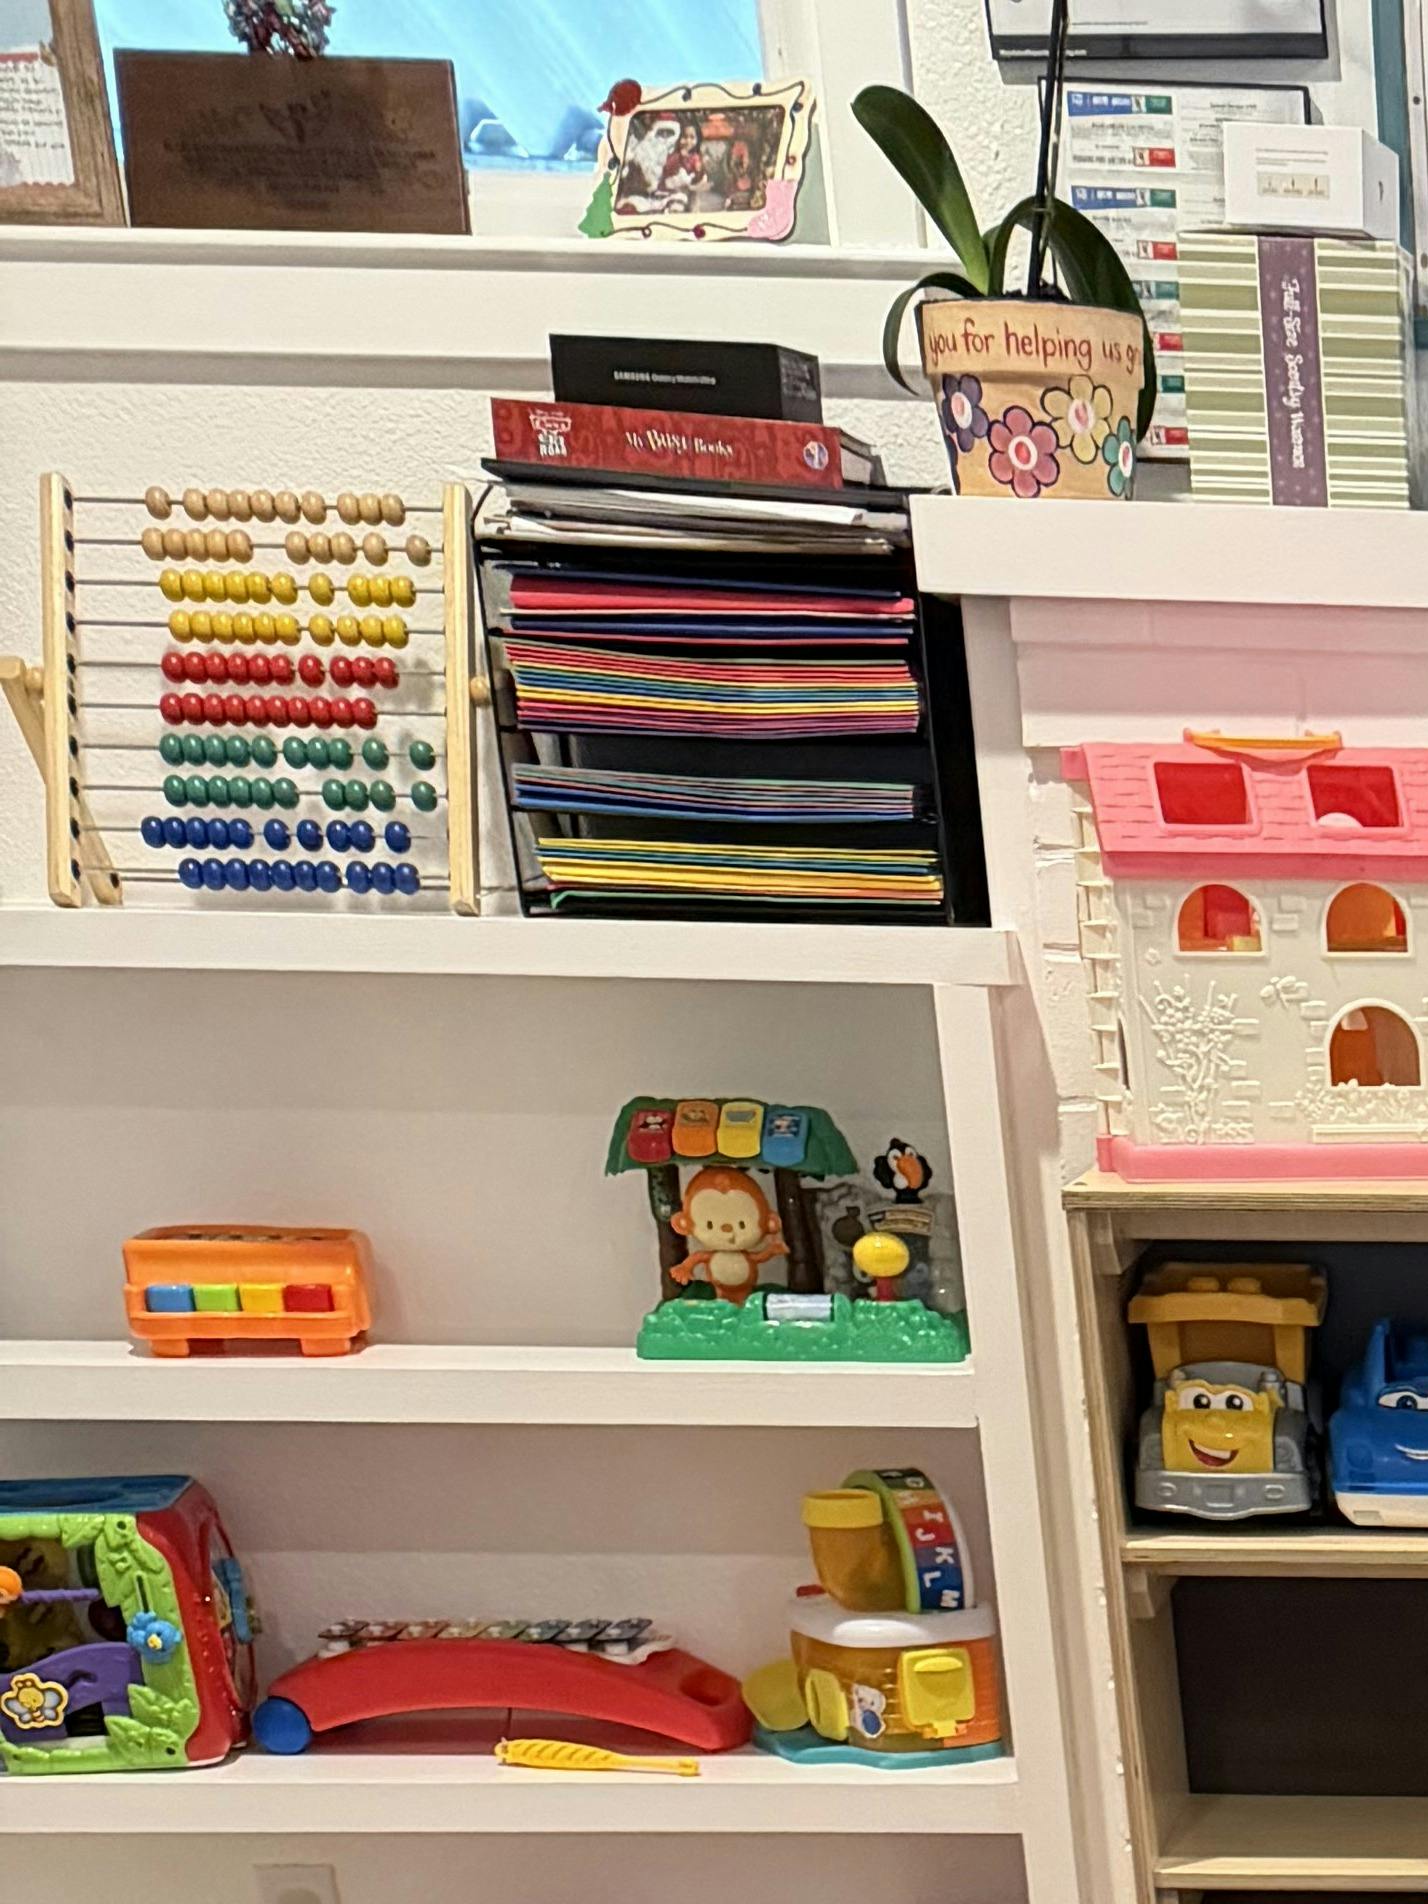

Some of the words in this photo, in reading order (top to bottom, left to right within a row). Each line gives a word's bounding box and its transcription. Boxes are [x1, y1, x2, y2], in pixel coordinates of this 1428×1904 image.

[928, 328, 959, 367] you
[961, 317, 996, 354] for
[1003, 320, 1094, 373] helping
[1101, 340, 1122, 362] us
